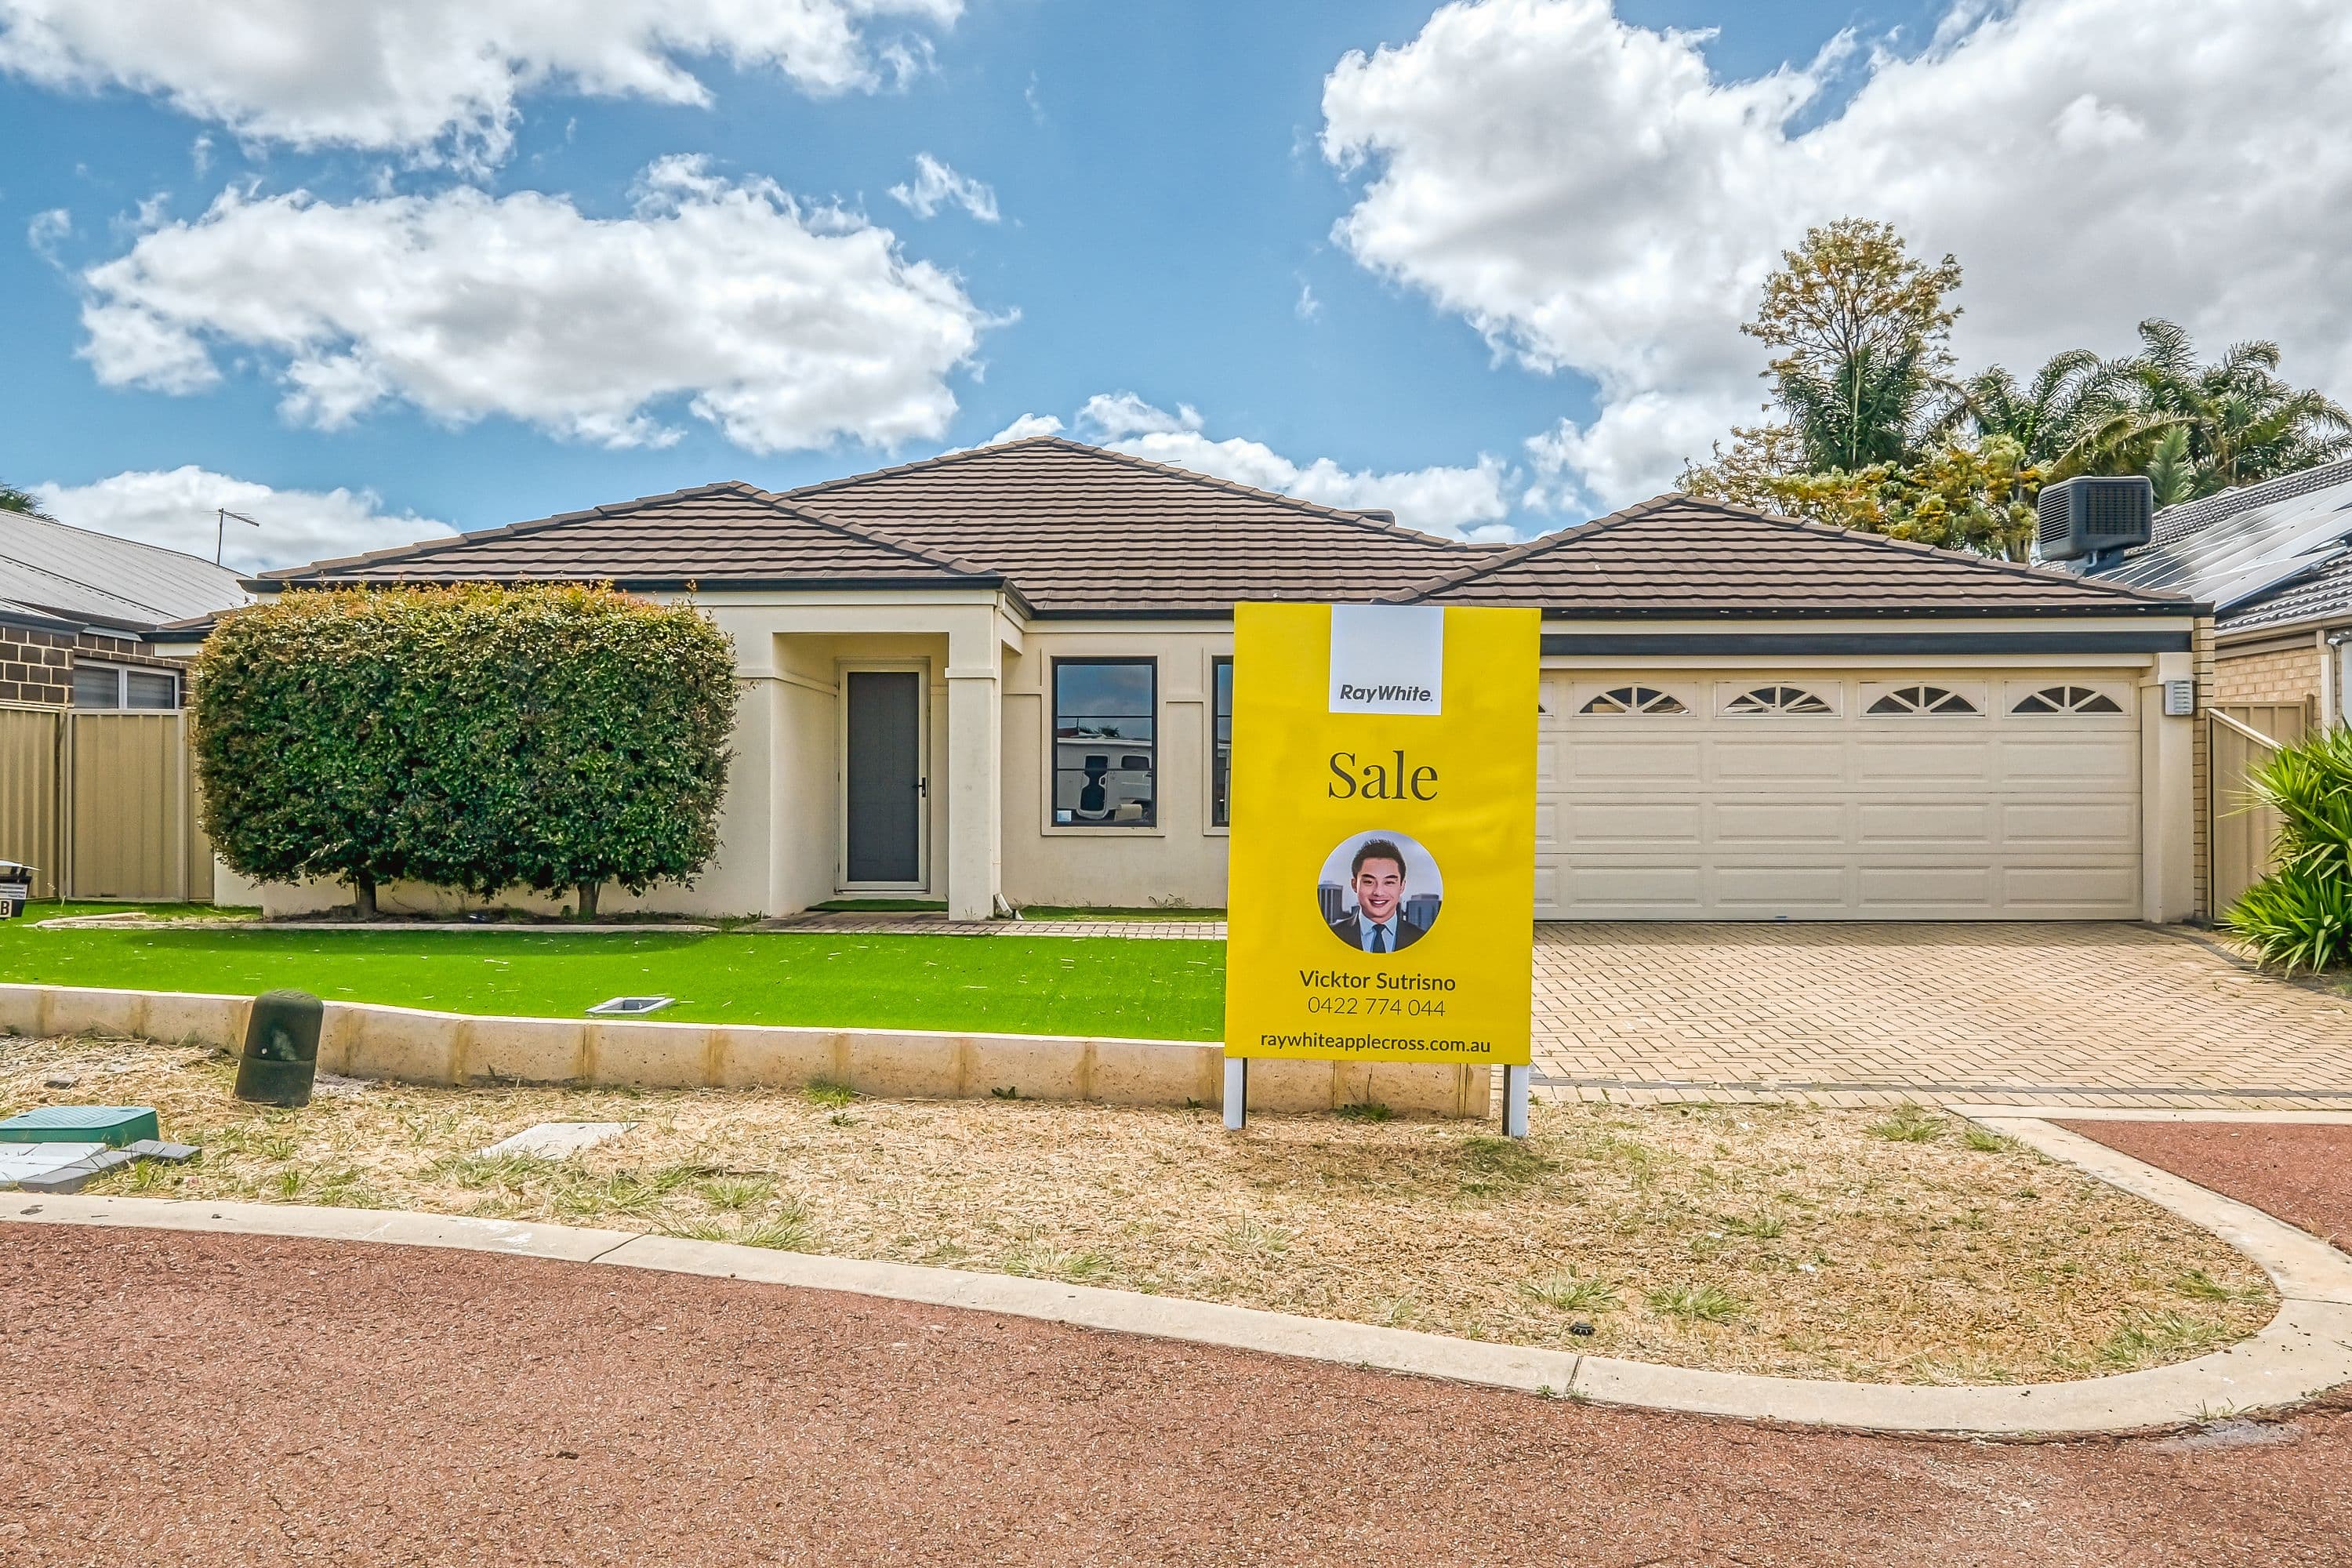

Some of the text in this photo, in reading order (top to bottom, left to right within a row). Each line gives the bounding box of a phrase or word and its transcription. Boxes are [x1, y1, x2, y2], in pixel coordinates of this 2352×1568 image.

[1328, 750, 1438, 801] Sale
[1299, 970, 1456, 991] Vicktor Sutrisno
[1308, 996, 1446, 1017] 0422 774 044
[1261, 1032, 1490, 1053] raywhiteapplecross.com.au
